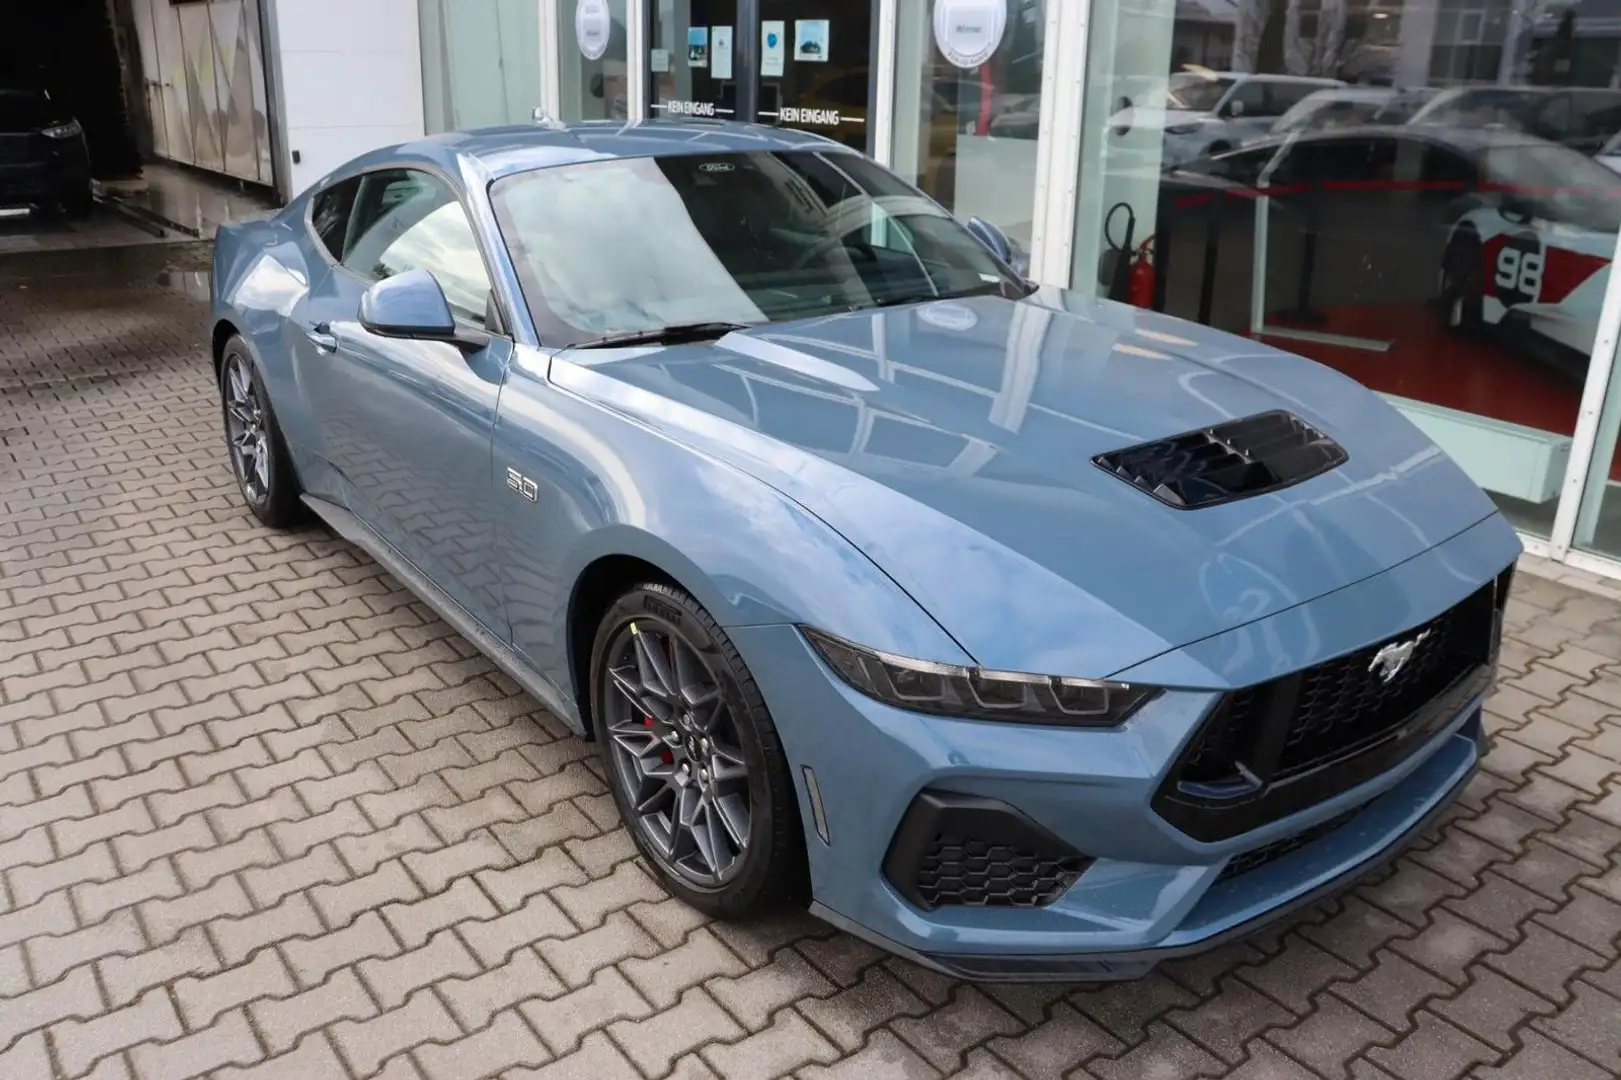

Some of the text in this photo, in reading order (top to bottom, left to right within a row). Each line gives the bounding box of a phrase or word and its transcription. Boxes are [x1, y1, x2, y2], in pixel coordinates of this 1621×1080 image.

[667, 101, 715, 116] KEIN EINGANG
[779, 107, 839, 125] KEIN EINGANG
[1495, 246, 1541, 296] 98
